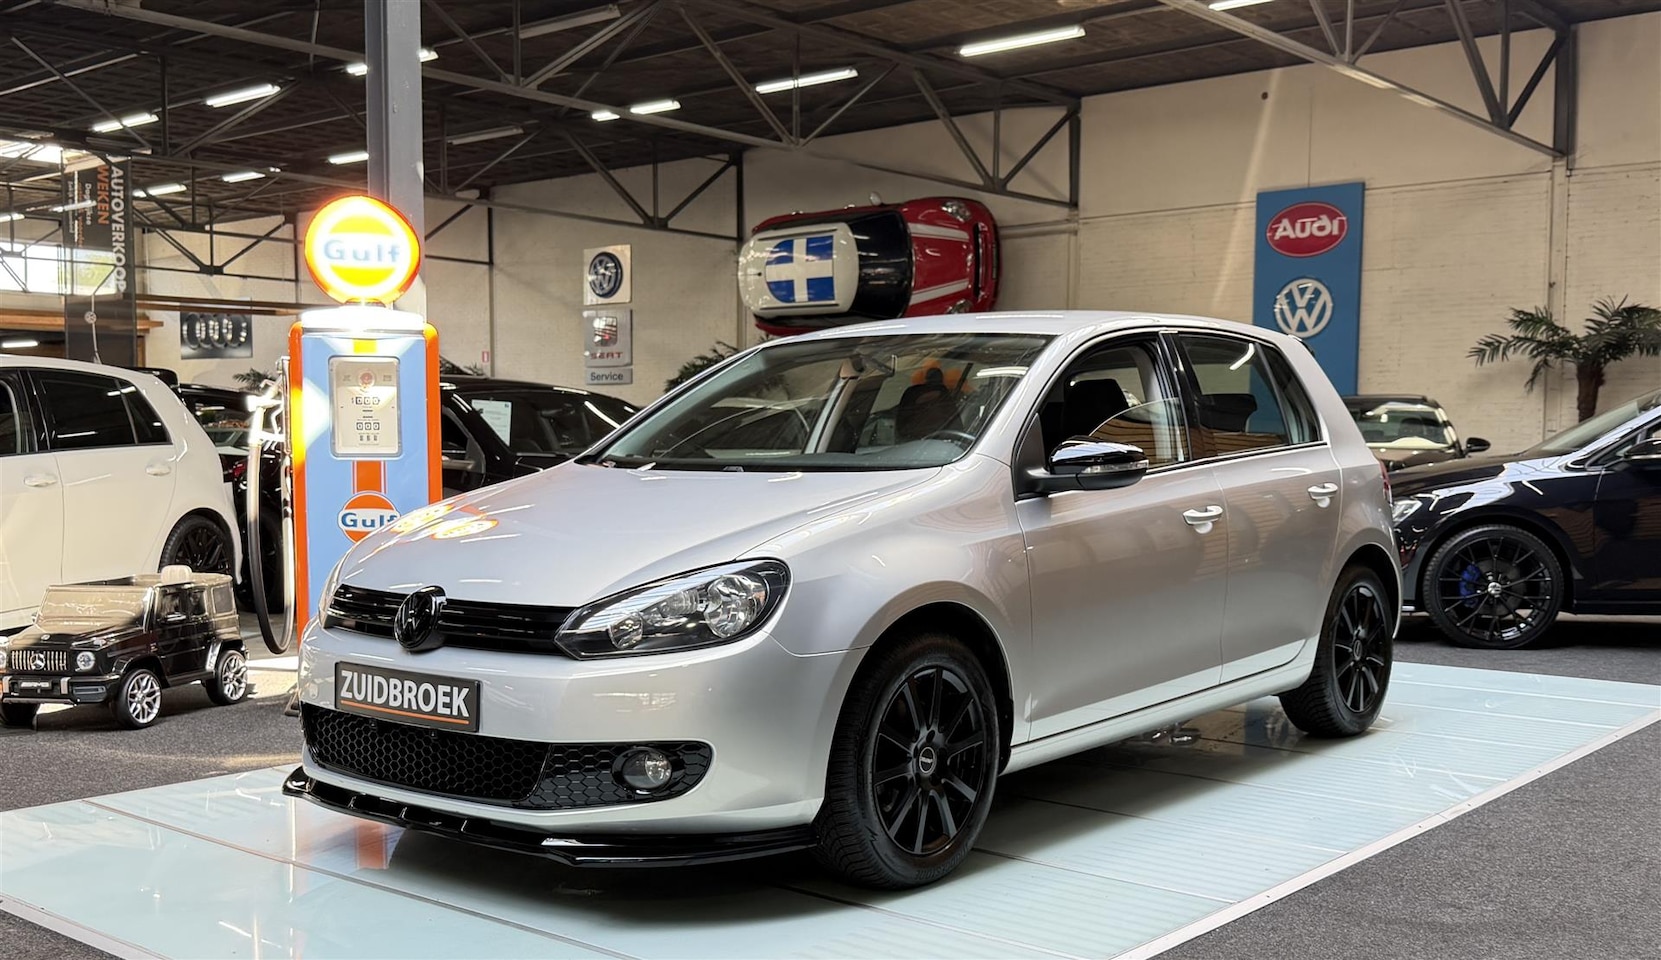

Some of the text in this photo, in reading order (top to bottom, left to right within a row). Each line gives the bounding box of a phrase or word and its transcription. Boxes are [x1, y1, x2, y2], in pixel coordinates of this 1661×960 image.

[97, 164, 110, 224] WEKEN
[111, 165, 127, 293] AUTOVERKOOP
[1274, 215, 1340, 240] Audi
[323, 239, 400, 262] Gulf
[591, 372, 624, 381] Service
[341, 670, 470, 717] ZUIDBROEK
